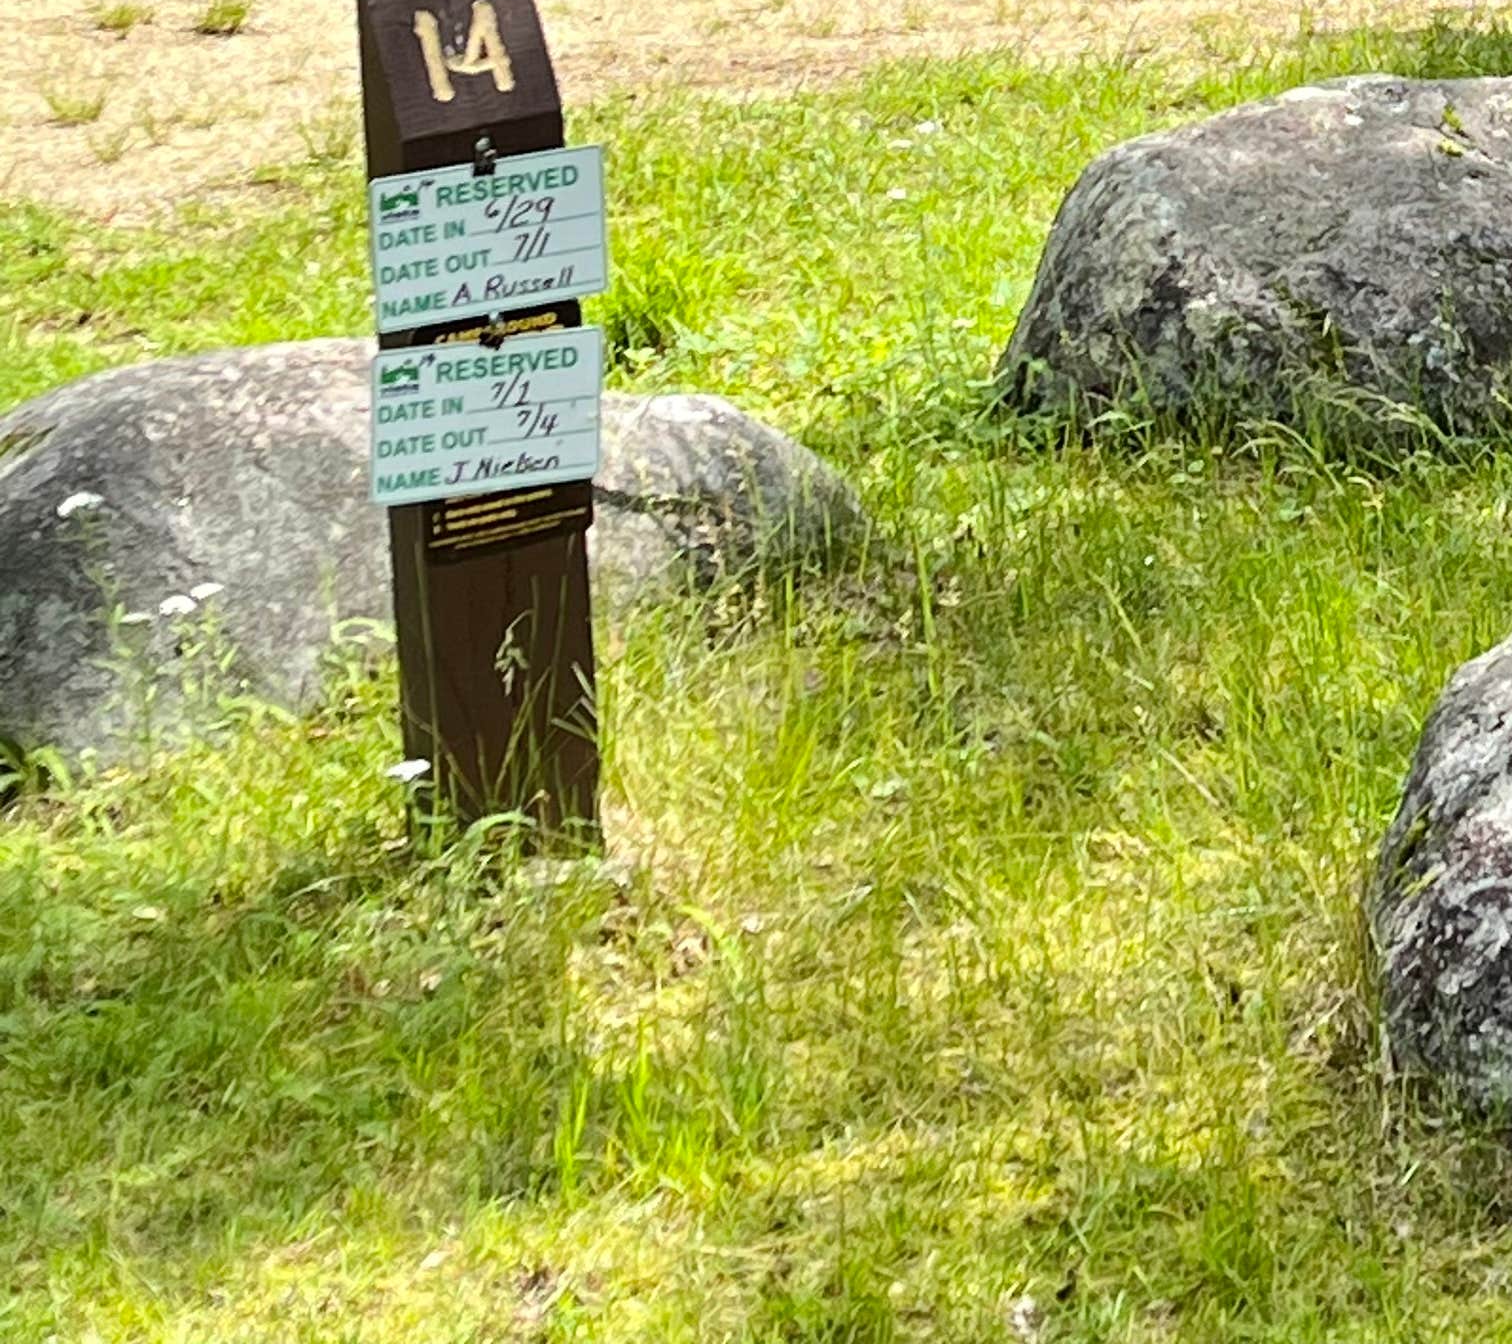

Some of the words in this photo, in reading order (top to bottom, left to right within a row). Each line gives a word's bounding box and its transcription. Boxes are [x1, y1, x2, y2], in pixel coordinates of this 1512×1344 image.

[436, 165, 579, 208] RESERVED
[378, 224, 437, 251] DATE
[443, 219, 466, 239] IN
[483, 194, 556, 234] 6/29
[380, 257, 440, 285] DATE
[444, 248, 493, 274] OUT
[513, 226, 552, 263] 7/1
[381, 291, 447, 319] NAME
[450, 281, 473, 308] A
[483, 265, 575, 301] Russell
[435, 346, 579, 384] RESERVED
[378, 399, 436, 425] DATE
[441, 396, 464, 415] IN
[490, 369, 531, 409] 7/1
[378, 433, 436, 459] DATE
[441, 426, 489, 450] OUT
[516, 402, 559, 439] 7/4
[377, 467, 441, 494] NAME
[444, 459, 471, 485] J
